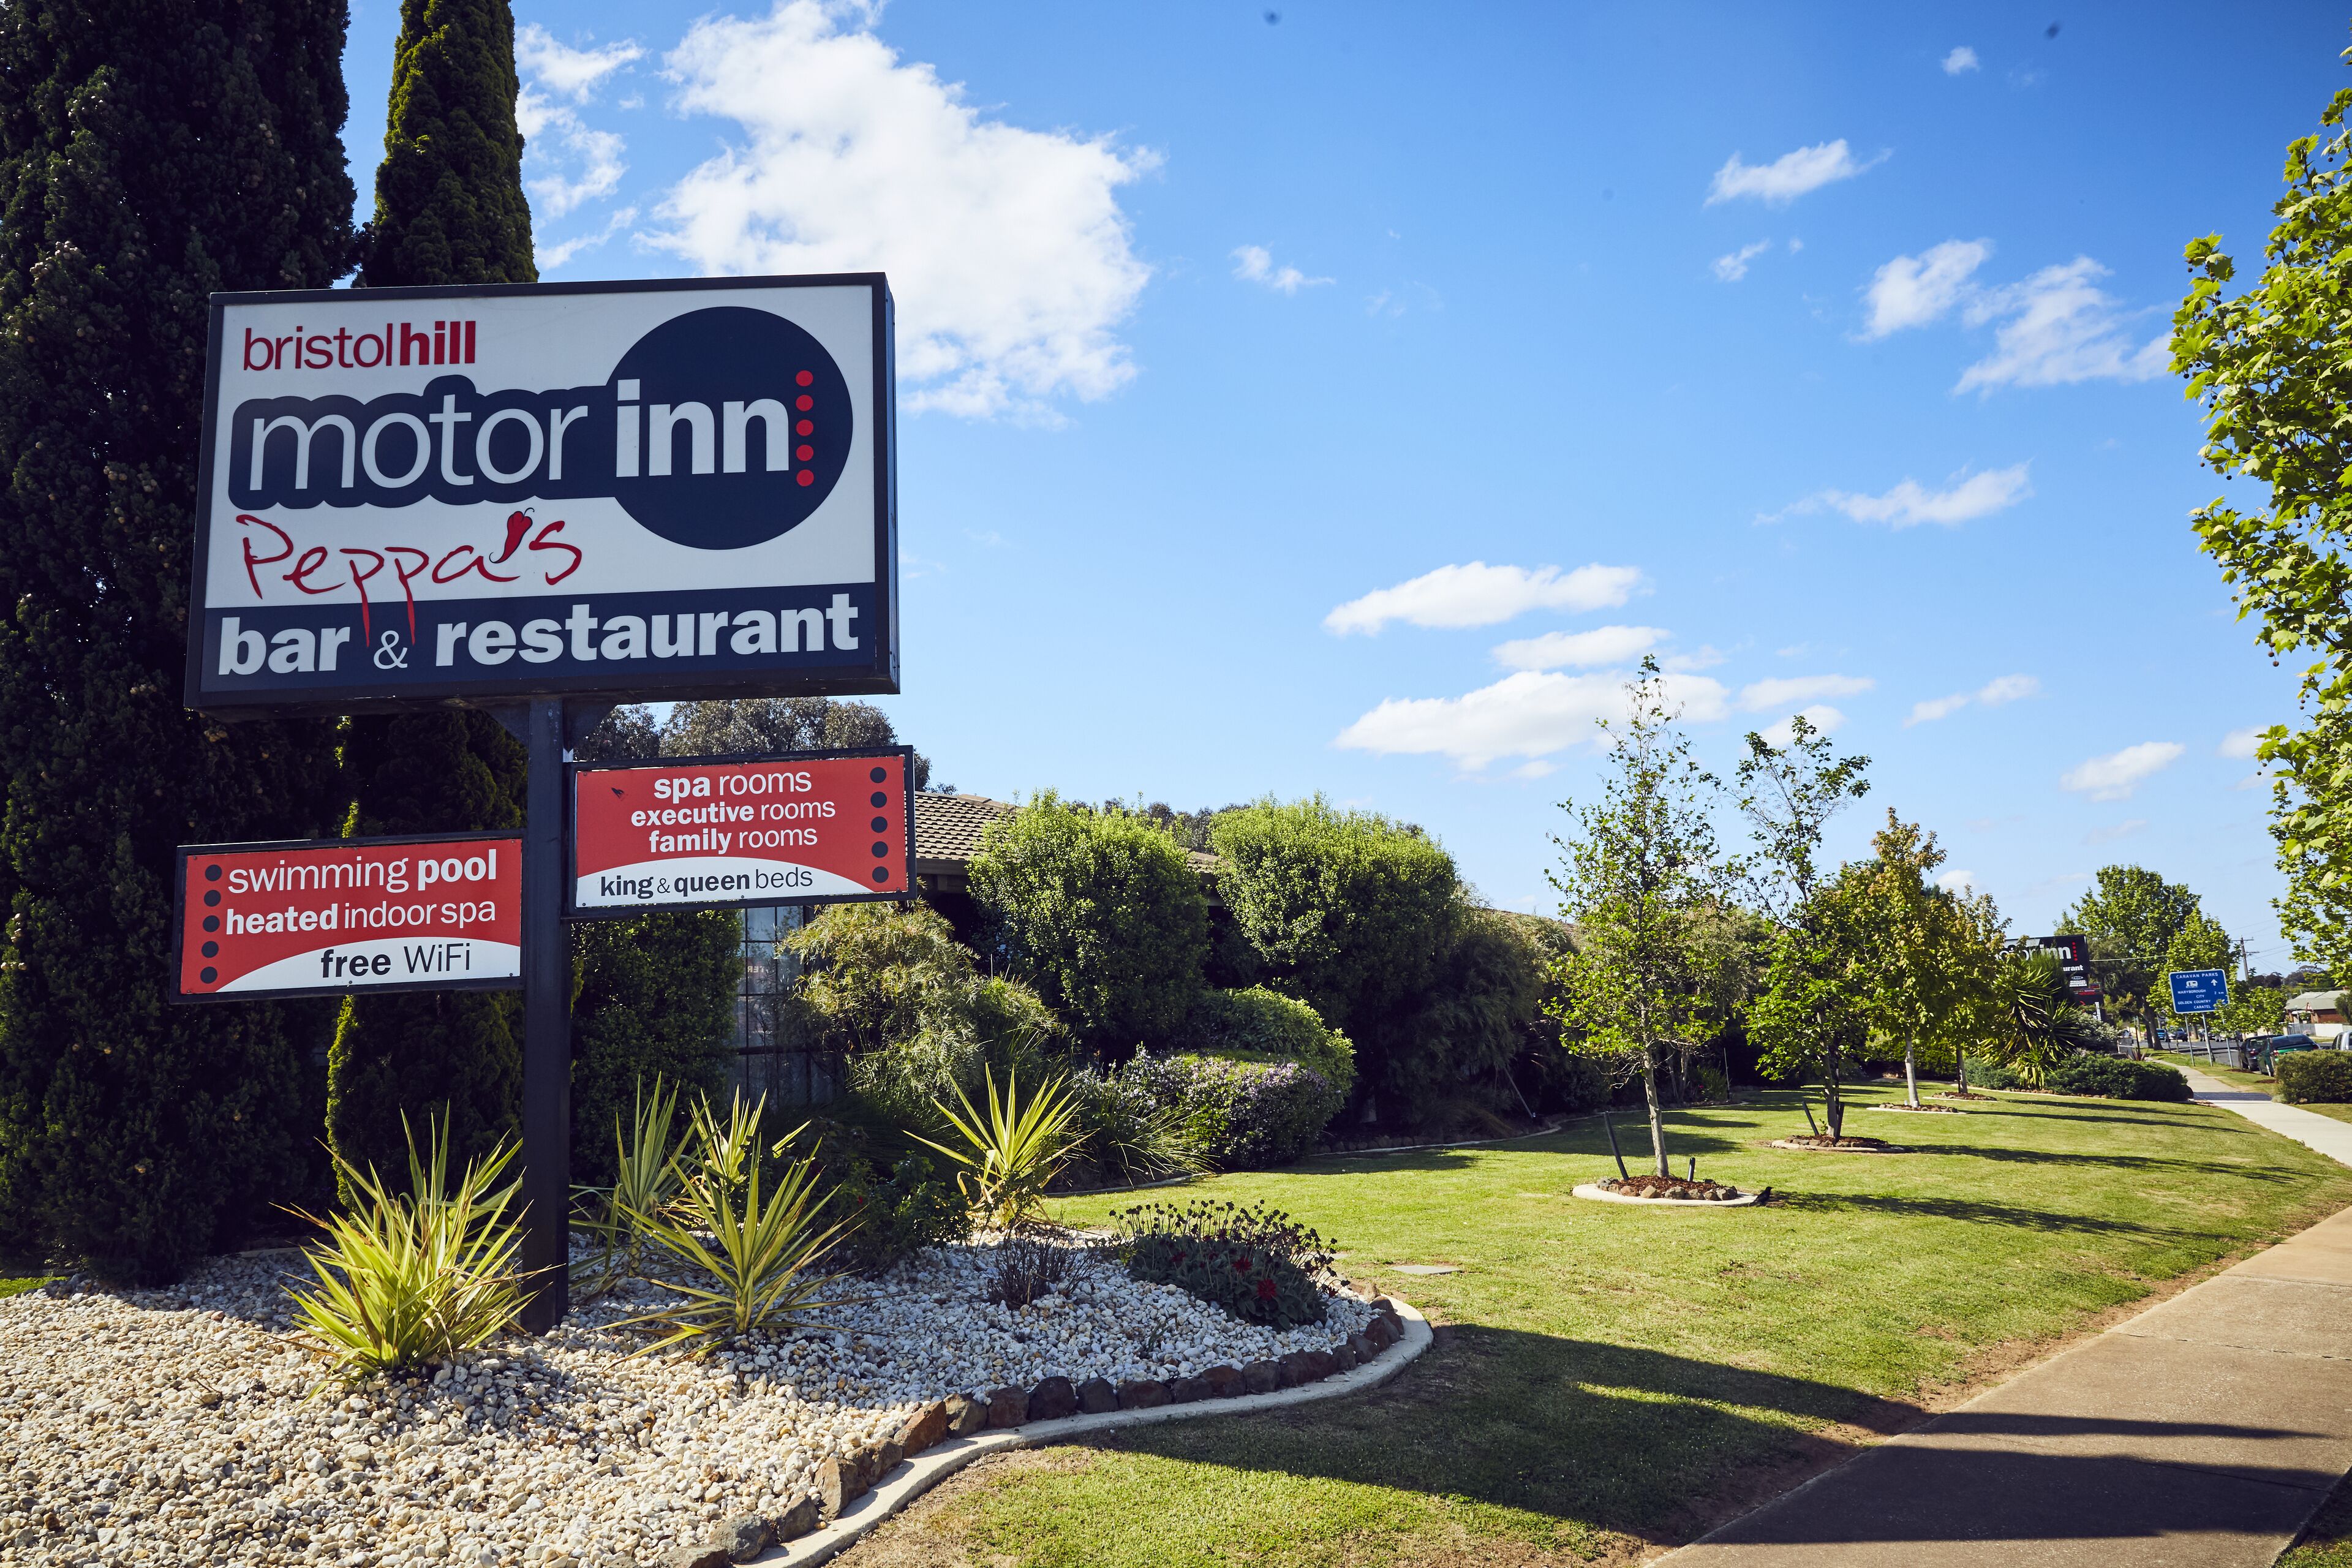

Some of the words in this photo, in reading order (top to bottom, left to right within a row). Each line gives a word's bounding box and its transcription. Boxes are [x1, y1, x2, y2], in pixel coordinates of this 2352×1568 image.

[250, 394, 589, 491] motor
[616, 378, 790, 478] inn
[236, 507, 582, 647] Peppa's
[218, 616, 350, 676] bar
[374, 630, 408, 669] &
[435, 593, 859, 667] restaurant
[654, 777, 710, 804] spa
[719, 771, 812, 796] rooms
[631, 801, 755, 827] executive
[761, 801, 835, 821] rooms
[649, 827, 733, 854] family
[739, 828, 818, 849] rooms
[228, 856, 409, 894] swimming
[418, 848, 497, 891] pool
[601, 875, 654, 899] king
[657, 878, 671, 894] &
[674, 873, 750, 897] queen
[756, 867, 813, 889] beds
[226, 903, 338, 935] heated
[344, 900, 437, 929] indoor
[440, 900, 496, 929] spa
[320, 949, 391, 978] free
[403, 943, 471, 973] WiFi
